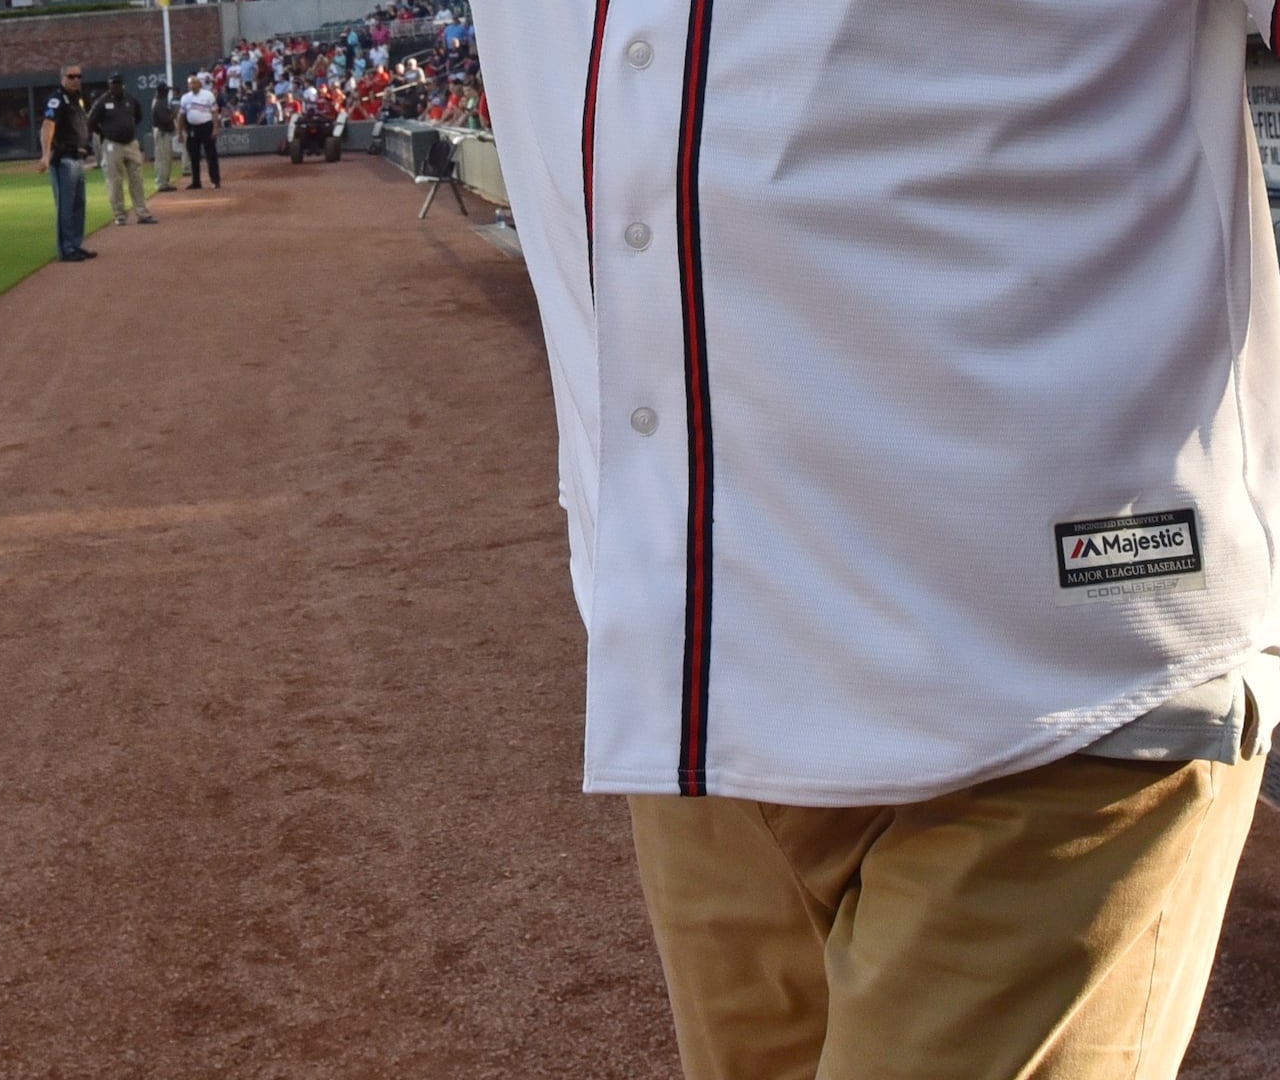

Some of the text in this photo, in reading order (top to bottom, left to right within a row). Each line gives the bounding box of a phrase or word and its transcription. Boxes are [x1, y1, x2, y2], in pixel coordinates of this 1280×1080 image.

[137, 75, 166, 89] 325
[1102, 529, 1185, 558] Majestic
[1068, 560, 1195, 584] MAJOR LEAGUE BASEBALL
